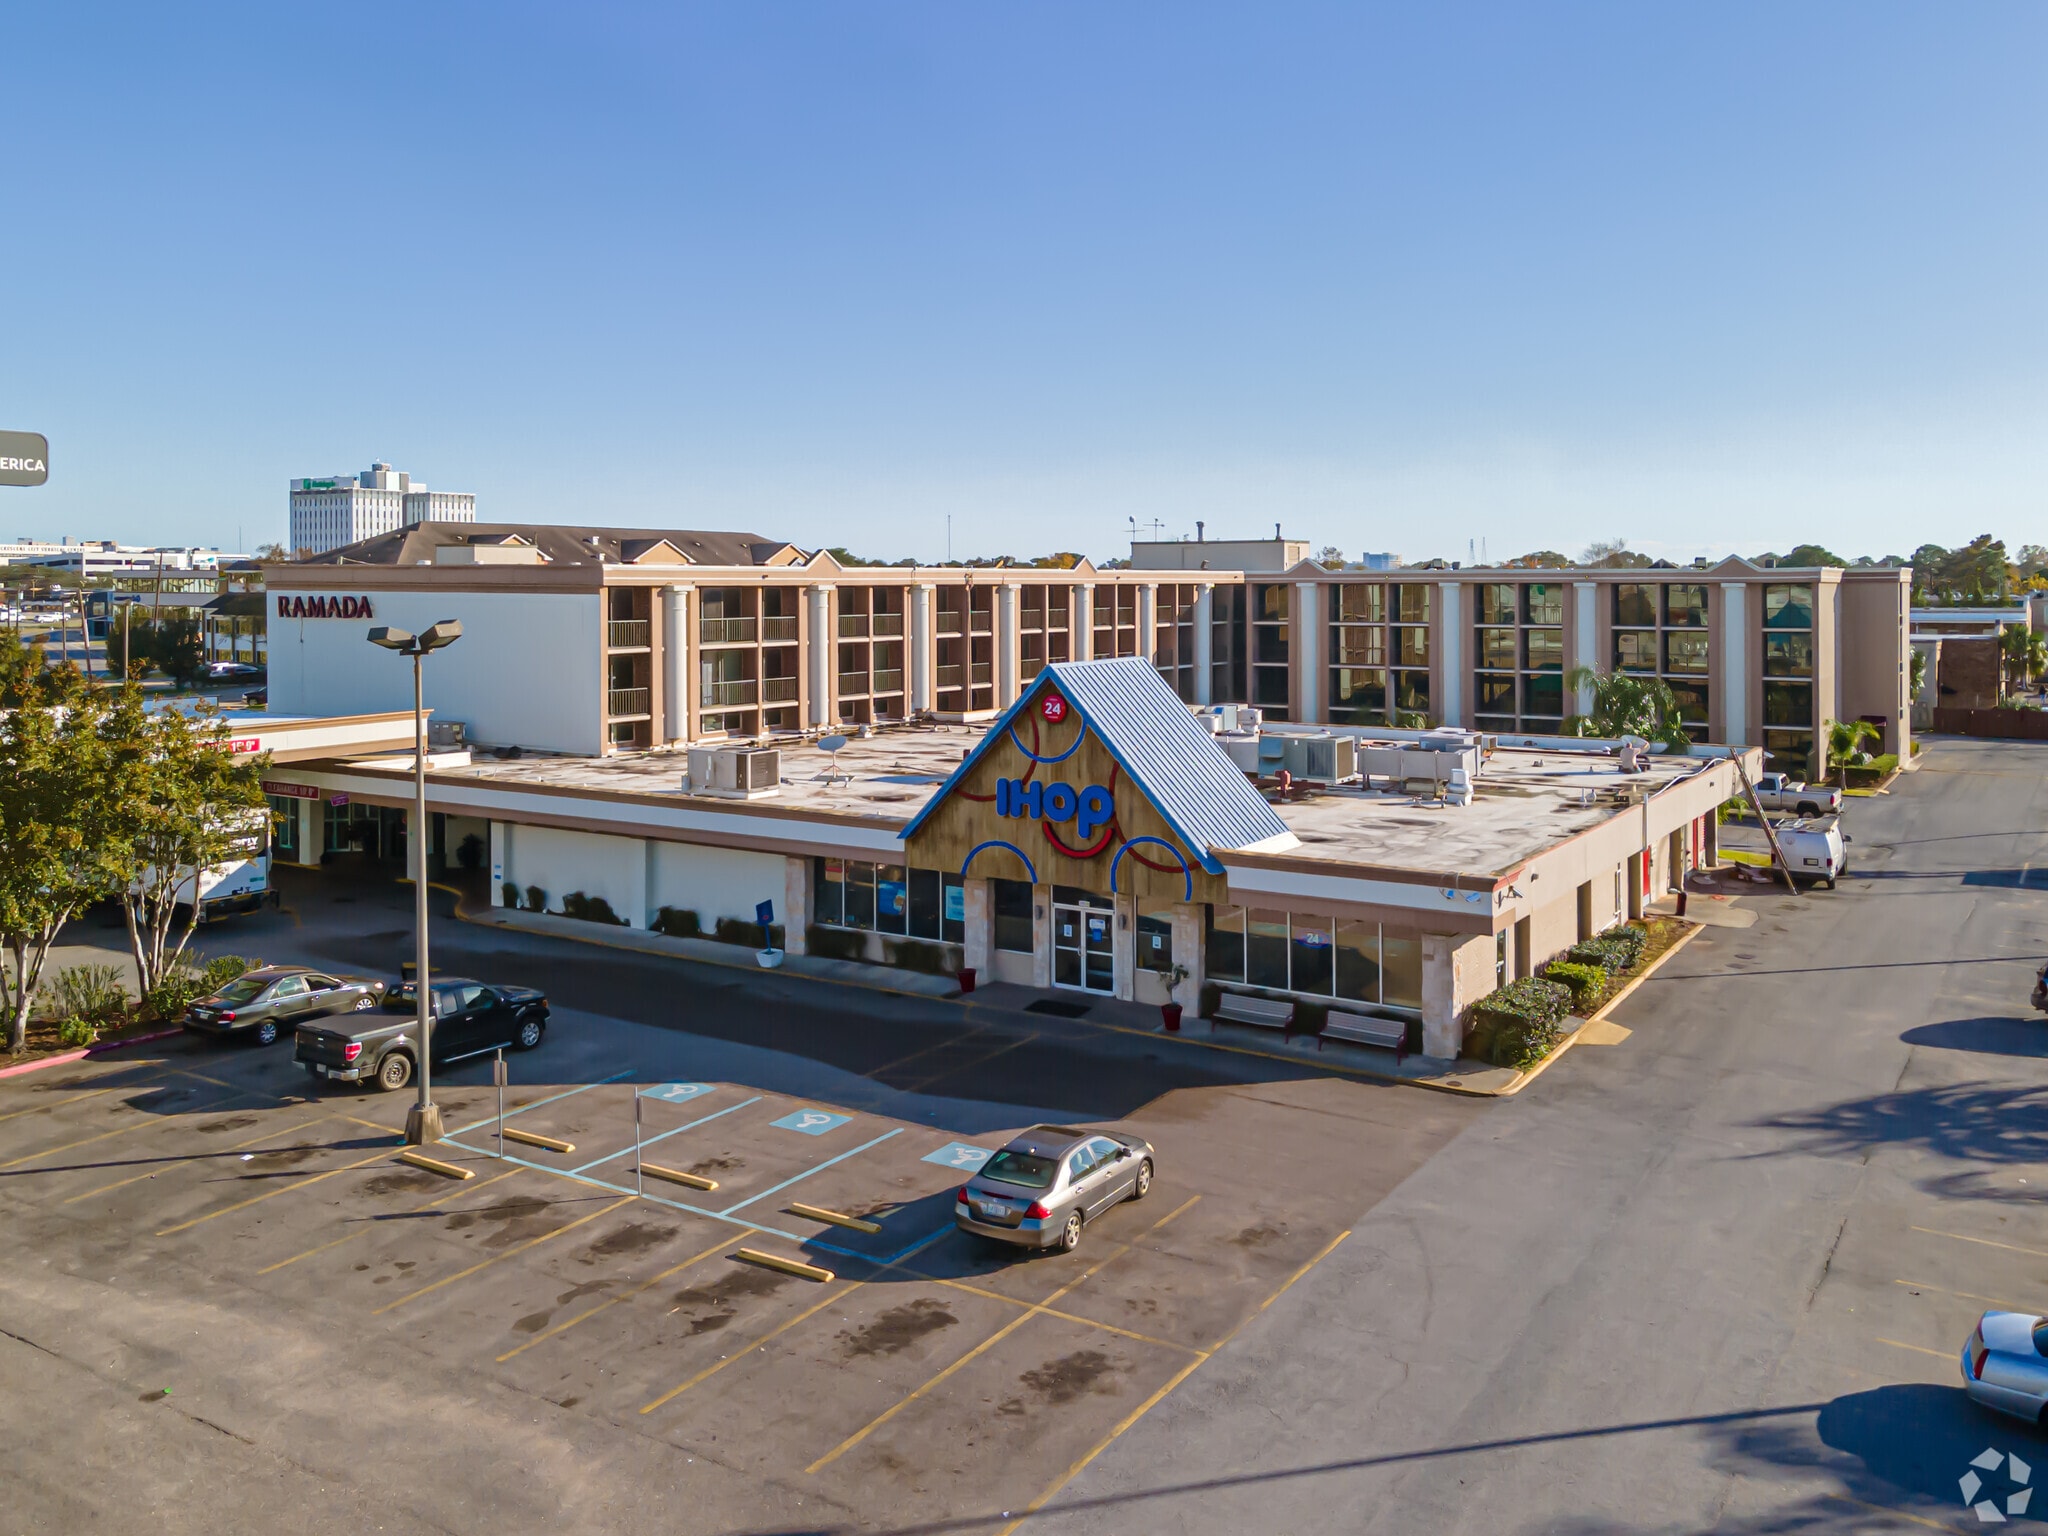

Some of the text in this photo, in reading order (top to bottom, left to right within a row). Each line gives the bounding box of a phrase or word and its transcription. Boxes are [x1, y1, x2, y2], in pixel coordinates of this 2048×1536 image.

[277, 595, 373, 618] RAMADA
[1045, 702, 1061, 715] 24
[1306, 932, 1319, 944] 24
